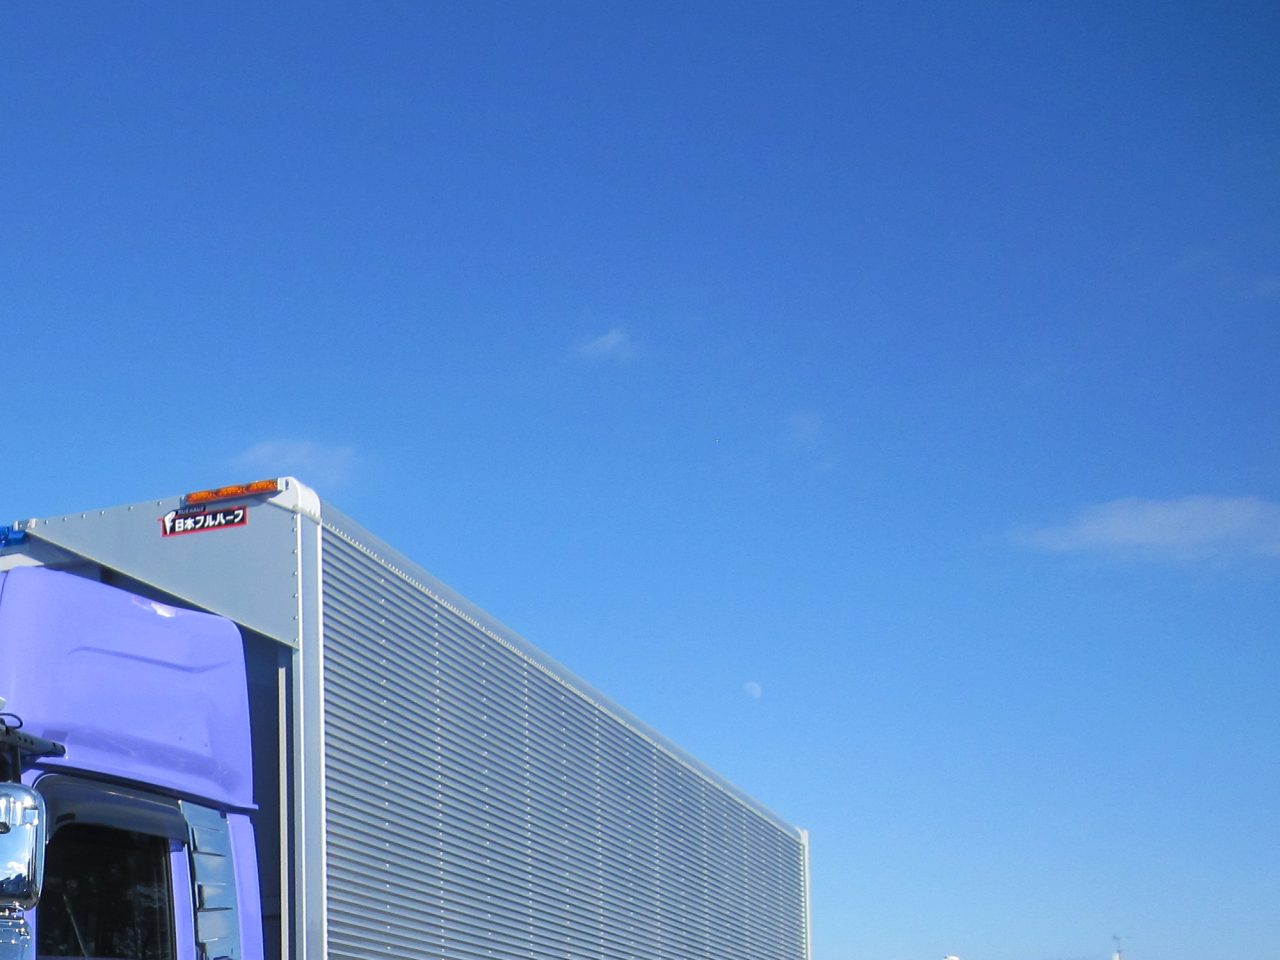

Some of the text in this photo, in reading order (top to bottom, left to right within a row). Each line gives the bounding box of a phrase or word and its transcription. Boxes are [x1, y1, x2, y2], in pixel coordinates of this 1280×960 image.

[175, 510, 244, 532] 日本フルハーフ
